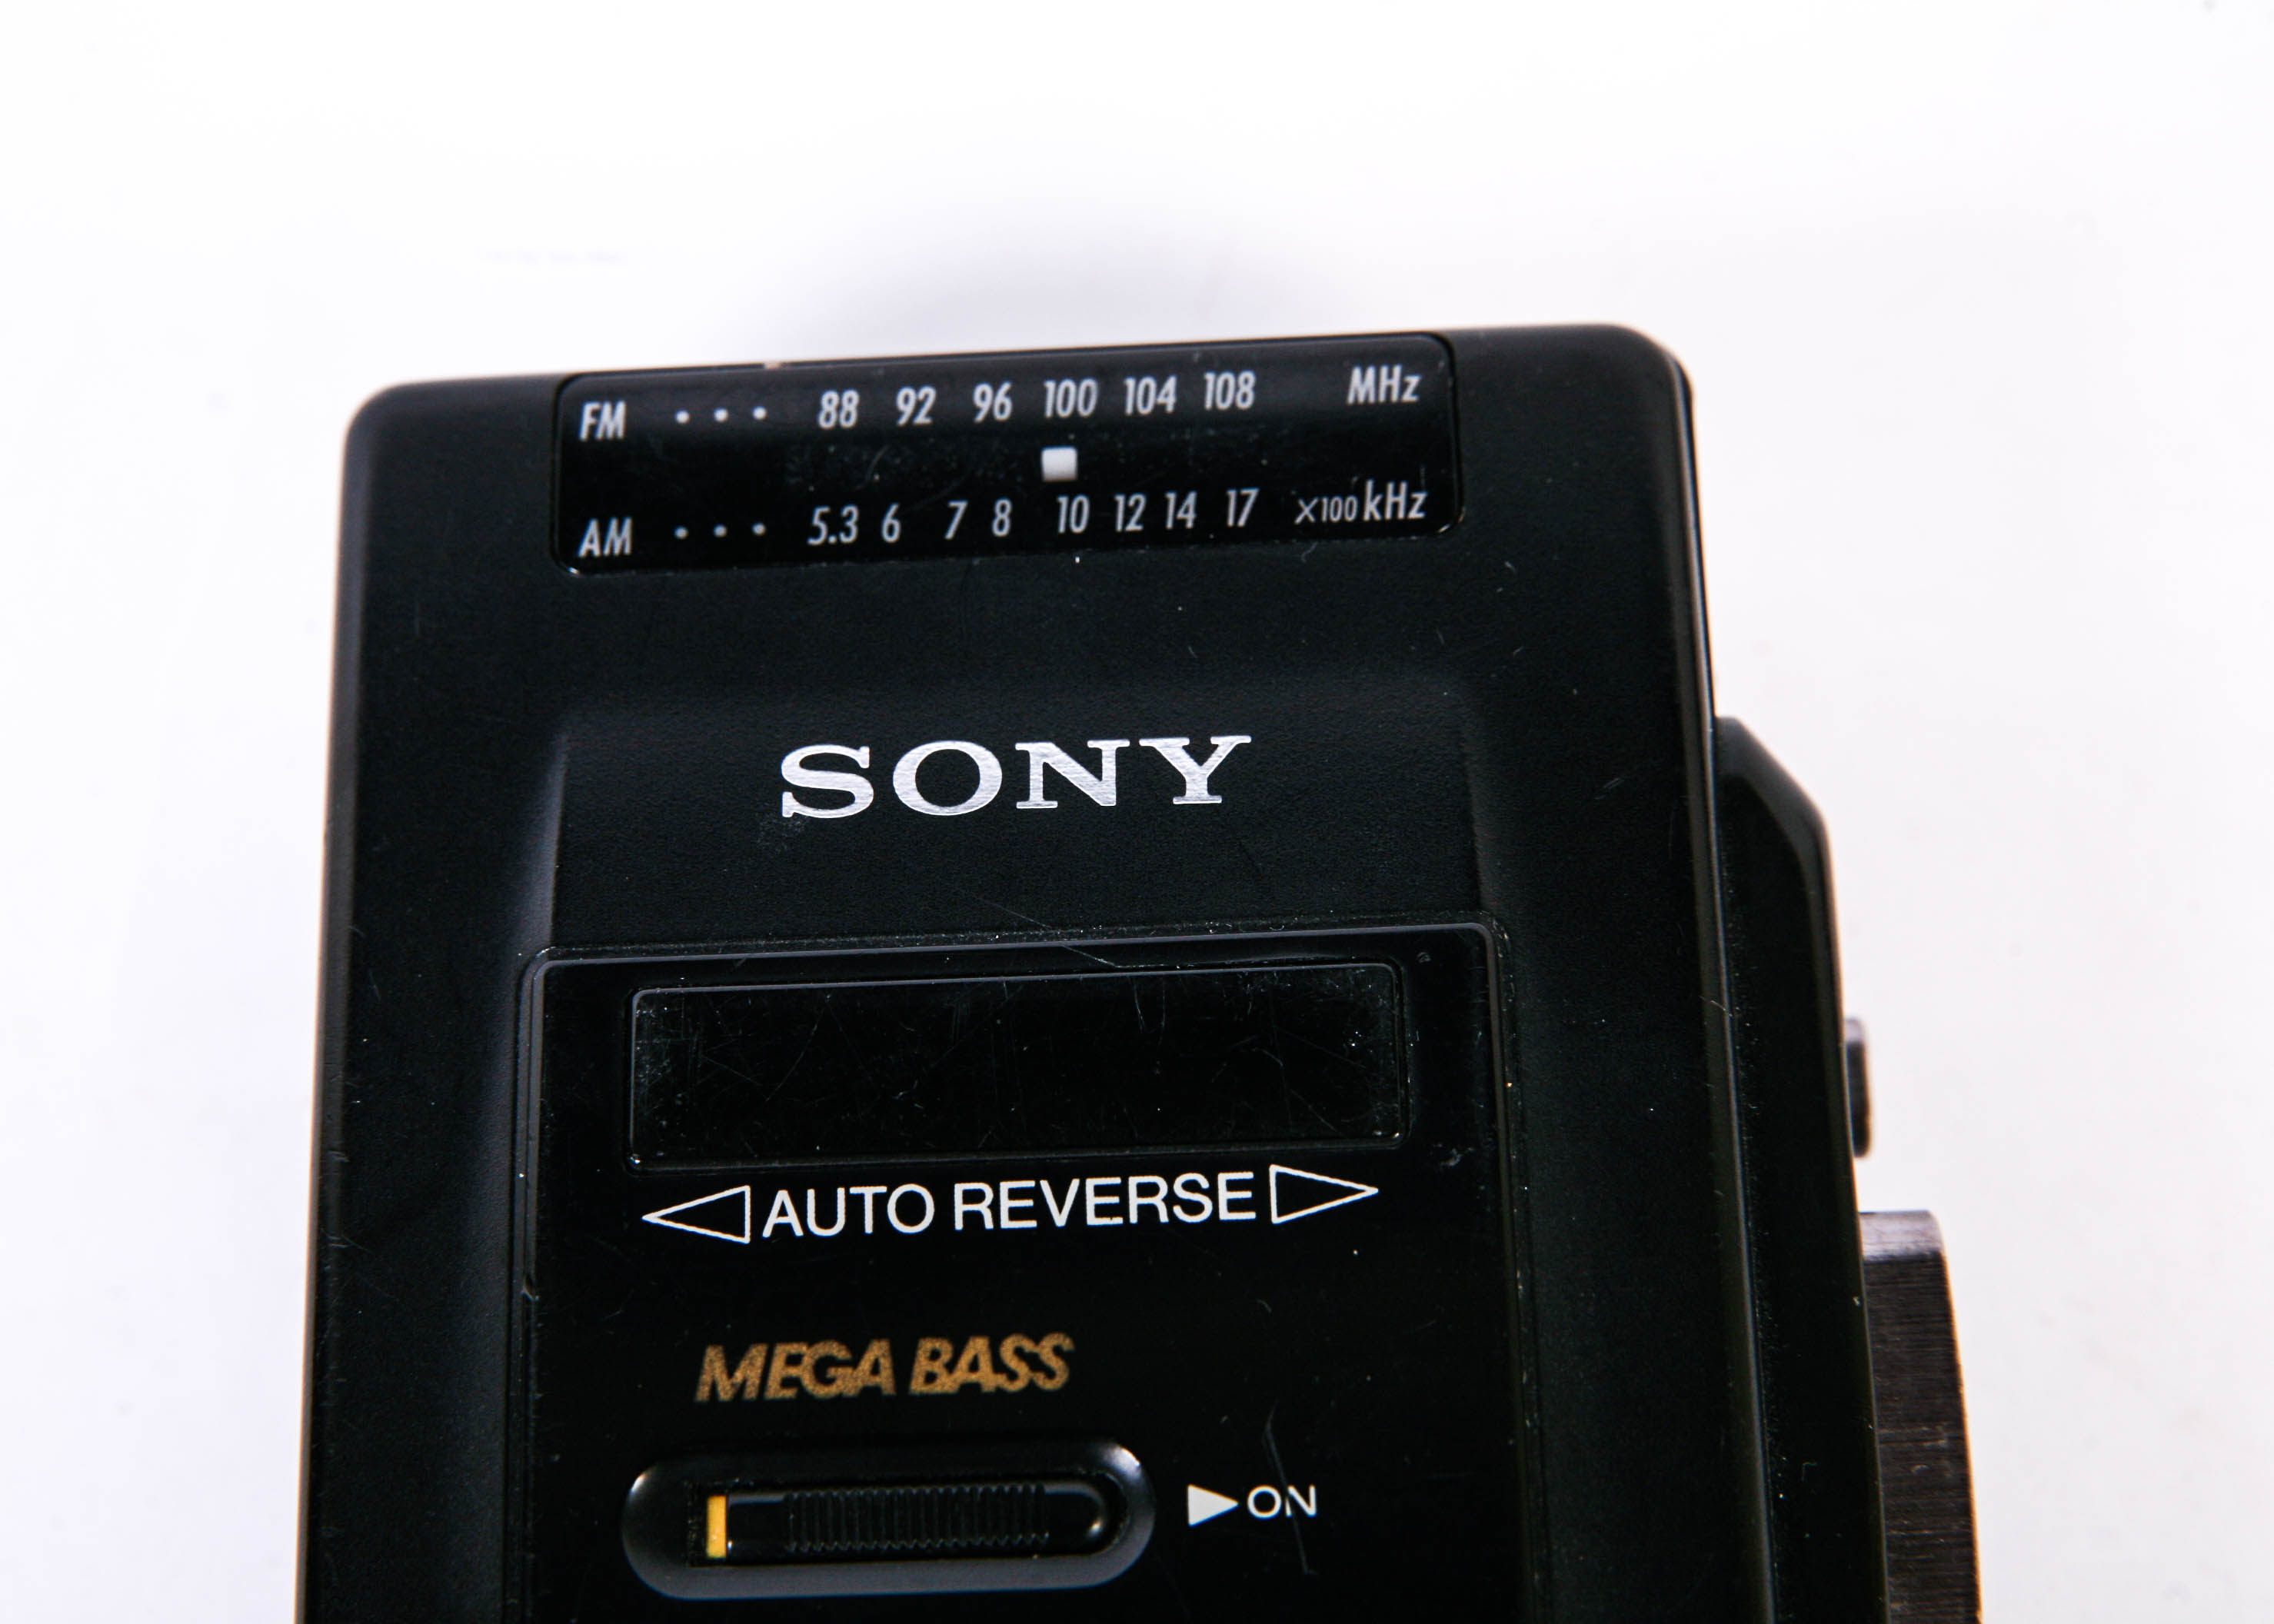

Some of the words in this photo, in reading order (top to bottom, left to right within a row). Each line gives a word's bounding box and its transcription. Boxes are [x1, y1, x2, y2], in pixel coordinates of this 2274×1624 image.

[578, 398, 628, 441] FM
[817, 388, 860, 430] 88
[894, 384, 937, 426] 92
[972, 380, 1014, 423] 96
[1043, 377, 1098, 418] 100
[1123, 374, 1178, 416] 104
[1203, 370, 1257, 411] 108
[1347, 363, 1422, 405] MHz
[578, 517, 632, 557] AM
[807, 504, 859, 546] 5.3
[881, 503, 901, 543] 6
[944, 500, 967, 540] 7
[991, 498, 1012, 537] 8
[1057, 494, 1090, 534] 10
[1114, 493, 1146, 532] 12
[1166, 491, 1197, 530] 14
[1227, 488, 1259, 527] 17
[1363, 480, 1427, 523] kHz
[780, 734, 1253, 820] SONY
[761, 1183, 936, 1239] AUTO
[953, 1170, 1257, 1232] REVERSE
[696, 1339, 895, 1403] MEGA
[909, 1333, 1074, 1395] BASS
[1246, 1484, 1318, 1519] ON
